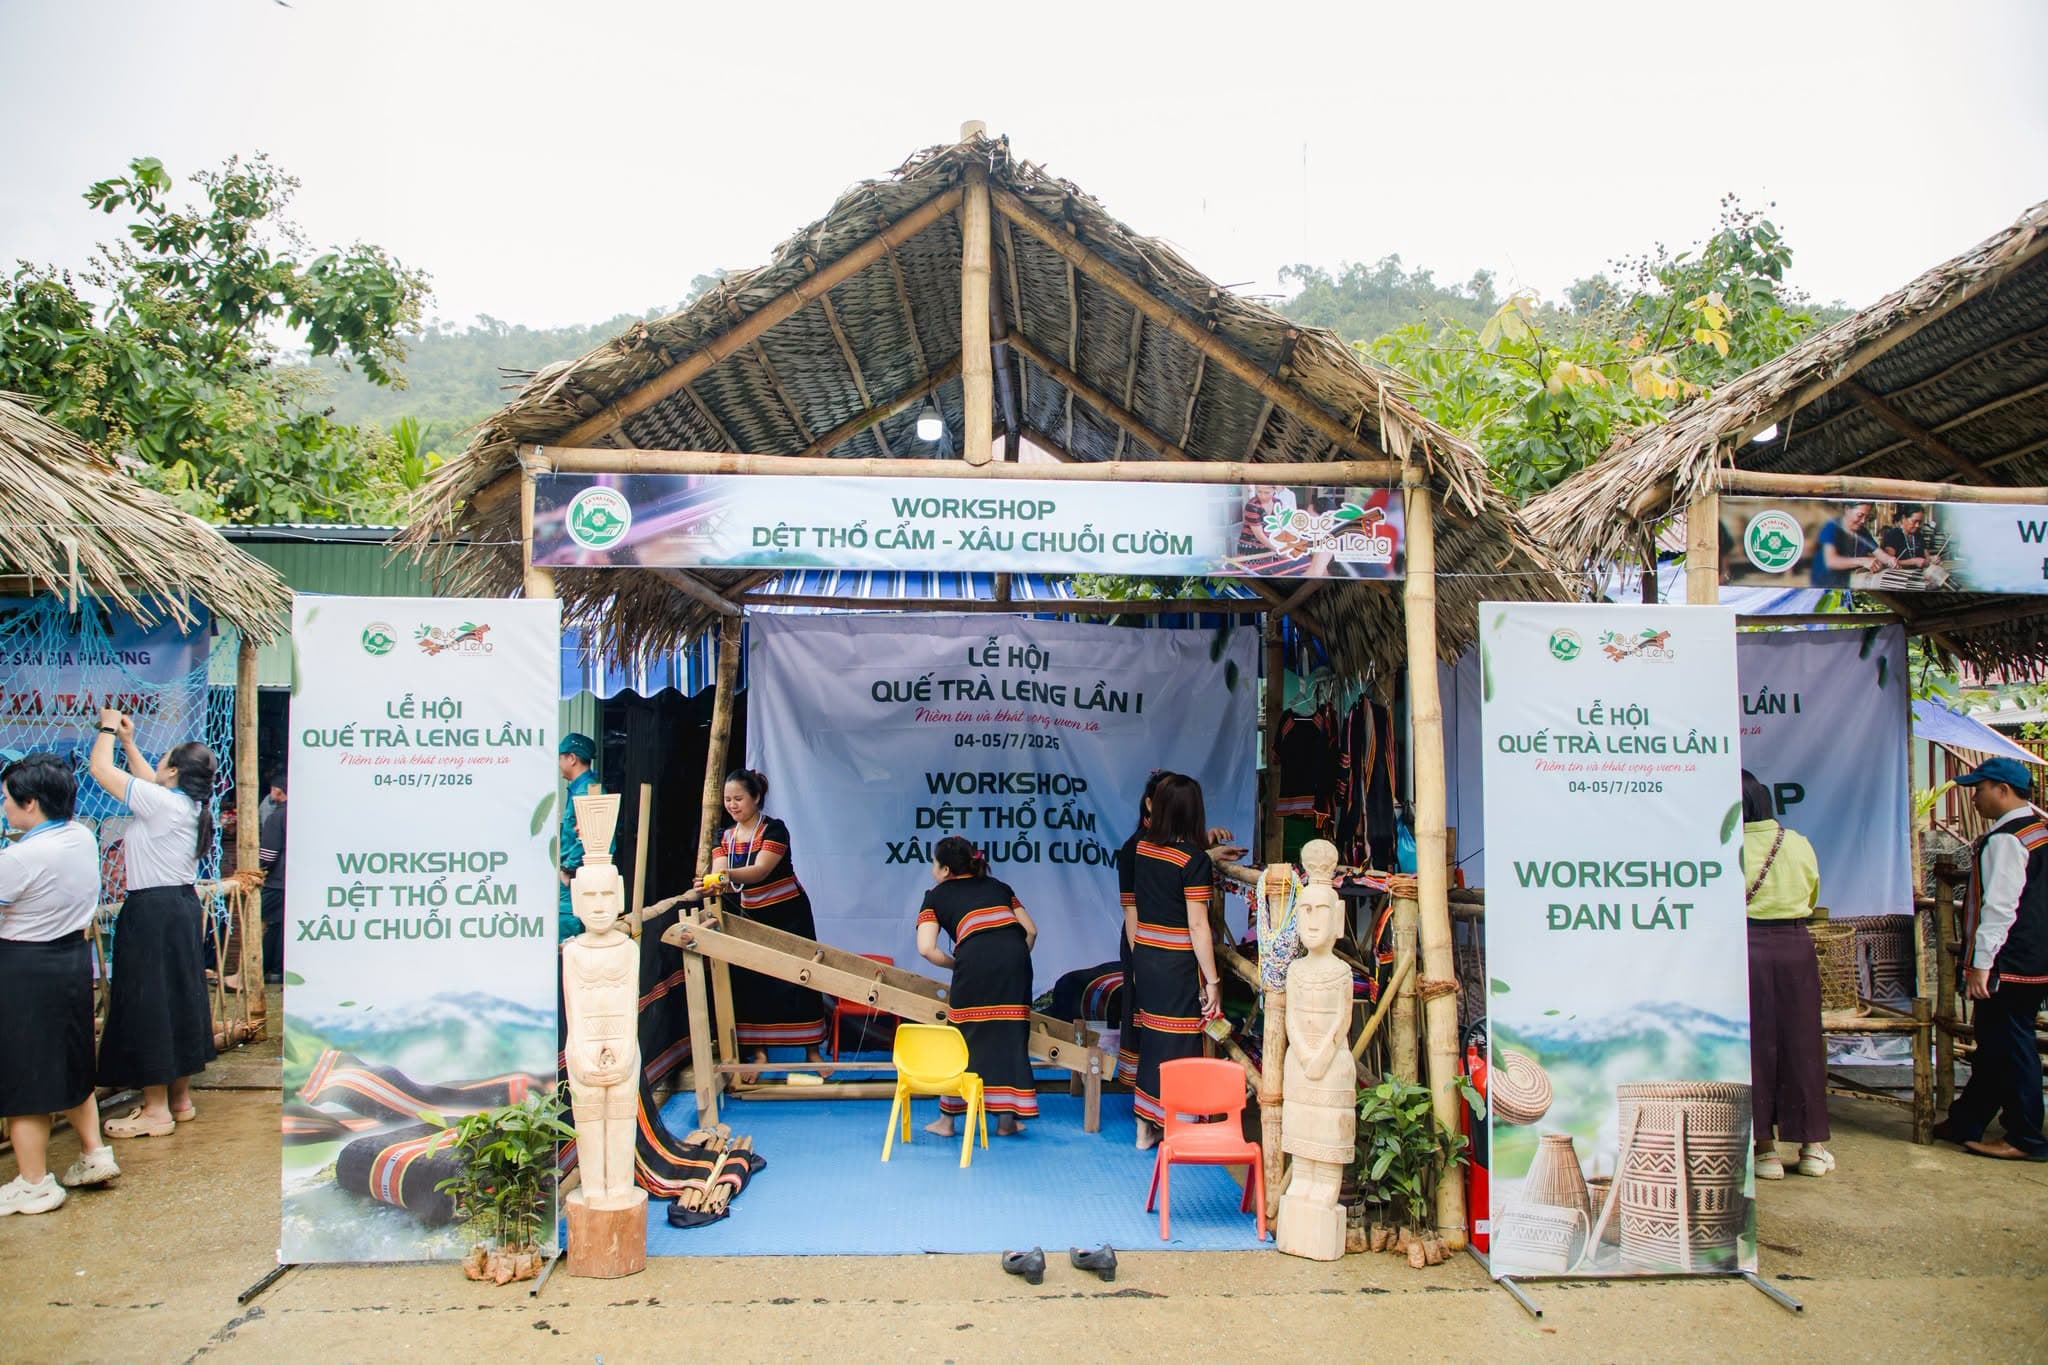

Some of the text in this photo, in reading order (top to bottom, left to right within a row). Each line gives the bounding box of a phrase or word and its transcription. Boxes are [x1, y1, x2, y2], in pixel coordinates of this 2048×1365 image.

[892, 498, 1056, 520] WORKSHOP
[752, 521, 806, 552] DỆT
[812, 519, 868, 548] THỔ
[874, 521, 935, 550] CẨM
[958, 526, 1014, 551] XÂU
[1022, 523, 1104, 553] CHUỖI
[1112, 529, 1193, 555] CƯỜM
[1345, 532, 1389, 554] Leng
[968, 636, 1050, 674] LỄ HỘI
[871, 671, 1143, 714] QUẾ TRÀ LENG LẦN I
[1742, 685, 1800, 715] LẦN I
[387, 693, 462, 723] LỄ HỘI
[914, 706, 952, 722] Niềm
[955, 711, 972, 722] tin
[976, 709, 992, 722] và
[994, 709, 1024, 722] khát
[1577, 699, 1649, 730] LỄ HỘI
[302, 721, 544, 748] QUẾ TRÀ LENG LẦN I
[954, 733, 1060, 750] 04-05/7/2026
[1498, 728, 1728, 754] QUẾ TRÀ LENG LẦN I
[339, 752, 371, 765] Niềm
[374, 755, 391, 765] tin
[394, 755, 406, 765] và
[410, 754, 433, 765] khát
[1535, 758, 1565, 772] Niềm
[1568, 761, 1583, 771] tin
[1586, 761, 1599, 771] và
[1601, 760, 1626, 771] khát
[374, 773, 473, 787] 04-05/7/2026
[925, 772, 1088, 797] WORKSHOP
[1569, 780, 1663, 794] 04-05/7/2026
[915, 797, 1096, 834] DỆT THỔ CẨM
[336, 851, 509, 874] WORKSHOP
[974, 831, 1040, 863] HUỖI
[1049, 838, 1119, 870] CƯỜM
[1514, 861, 1722, 888] WORKSHOP
[327, 875, 517, 912] DỆT THỔ CẨM
[296, 908, 544, 942] XÂU CHUỖI CƯỜM
[1546, 896, 1694, 930] ĐAN LÁT
